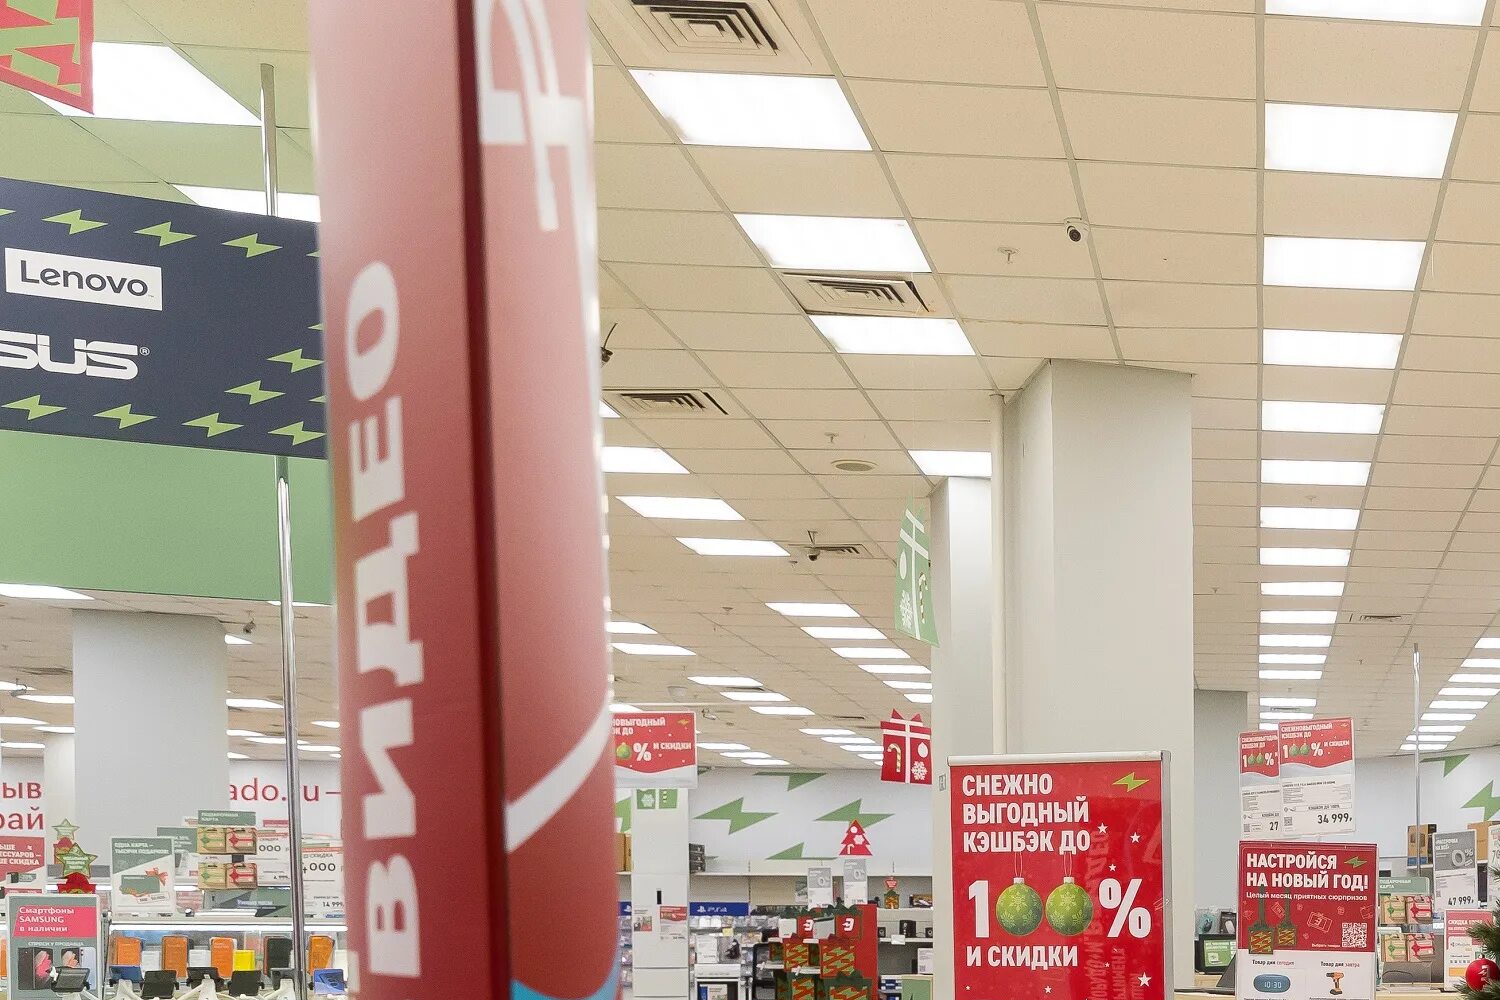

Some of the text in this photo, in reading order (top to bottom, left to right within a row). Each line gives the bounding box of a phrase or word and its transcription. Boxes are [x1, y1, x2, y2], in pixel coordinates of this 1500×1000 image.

[20, 259, 149, 297] Lenovo
[660, 742, 692, 751] СКИДКИ
[962, 773, 1053, 797] СНЕЖНО
[962, 795, 1089, 827] ВЫГОДНЫЙ
[1317, 814, 1329, 824] 34
[1269, 821, 1279, 831] 27
[963, 830, 1091, 855] КЭШБЭК ДО
[1246, 850, 1337, 870] НАСТРОЙСЯ
[1246, 870, 1369, 891] НА НОВЫЙ ГОД!
[1246, 891, 1270, 899] Целый
[19, 906, 75, 915] Смартфоны
[19, 916, 65, 924] SAMSUNG
[966, 945, 1078, 970] И СКИДКИ
